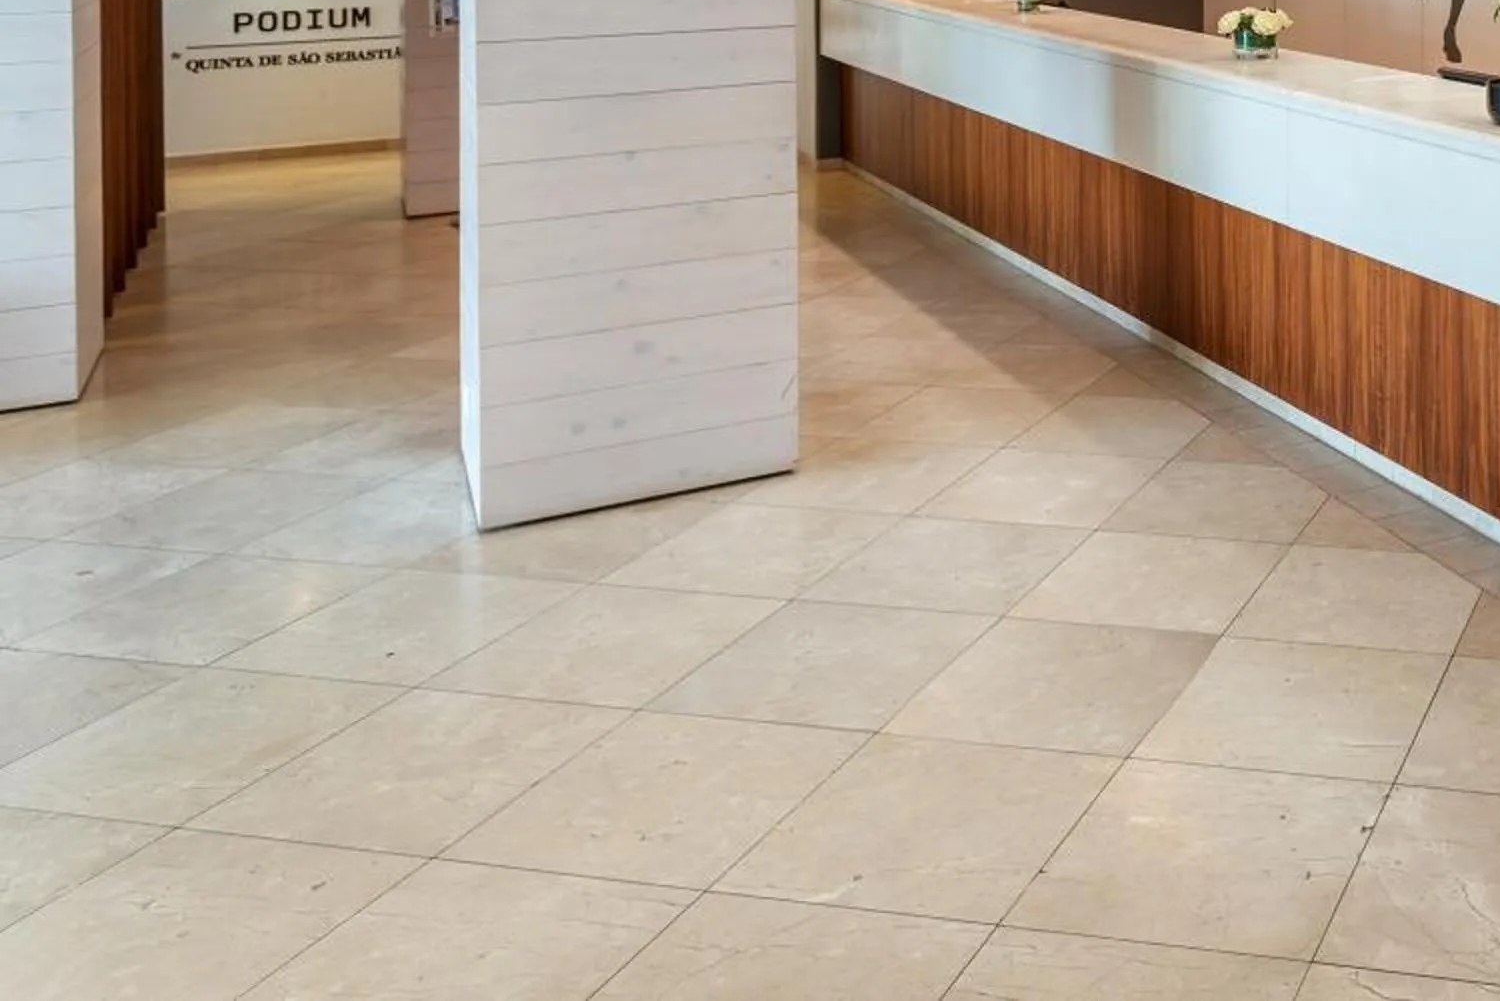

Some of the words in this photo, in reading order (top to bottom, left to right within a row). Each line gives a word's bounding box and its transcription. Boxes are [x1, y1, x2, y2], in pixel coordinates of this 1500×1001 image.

[233, 6, 372, 34] PODIUM
[184, 55, 255, 74] QUINTA
[258, 53, 283, 67] DE
[287, 49, 321, 66] SÃO
[325, 46, 402, 64] SEBASTIÃ
